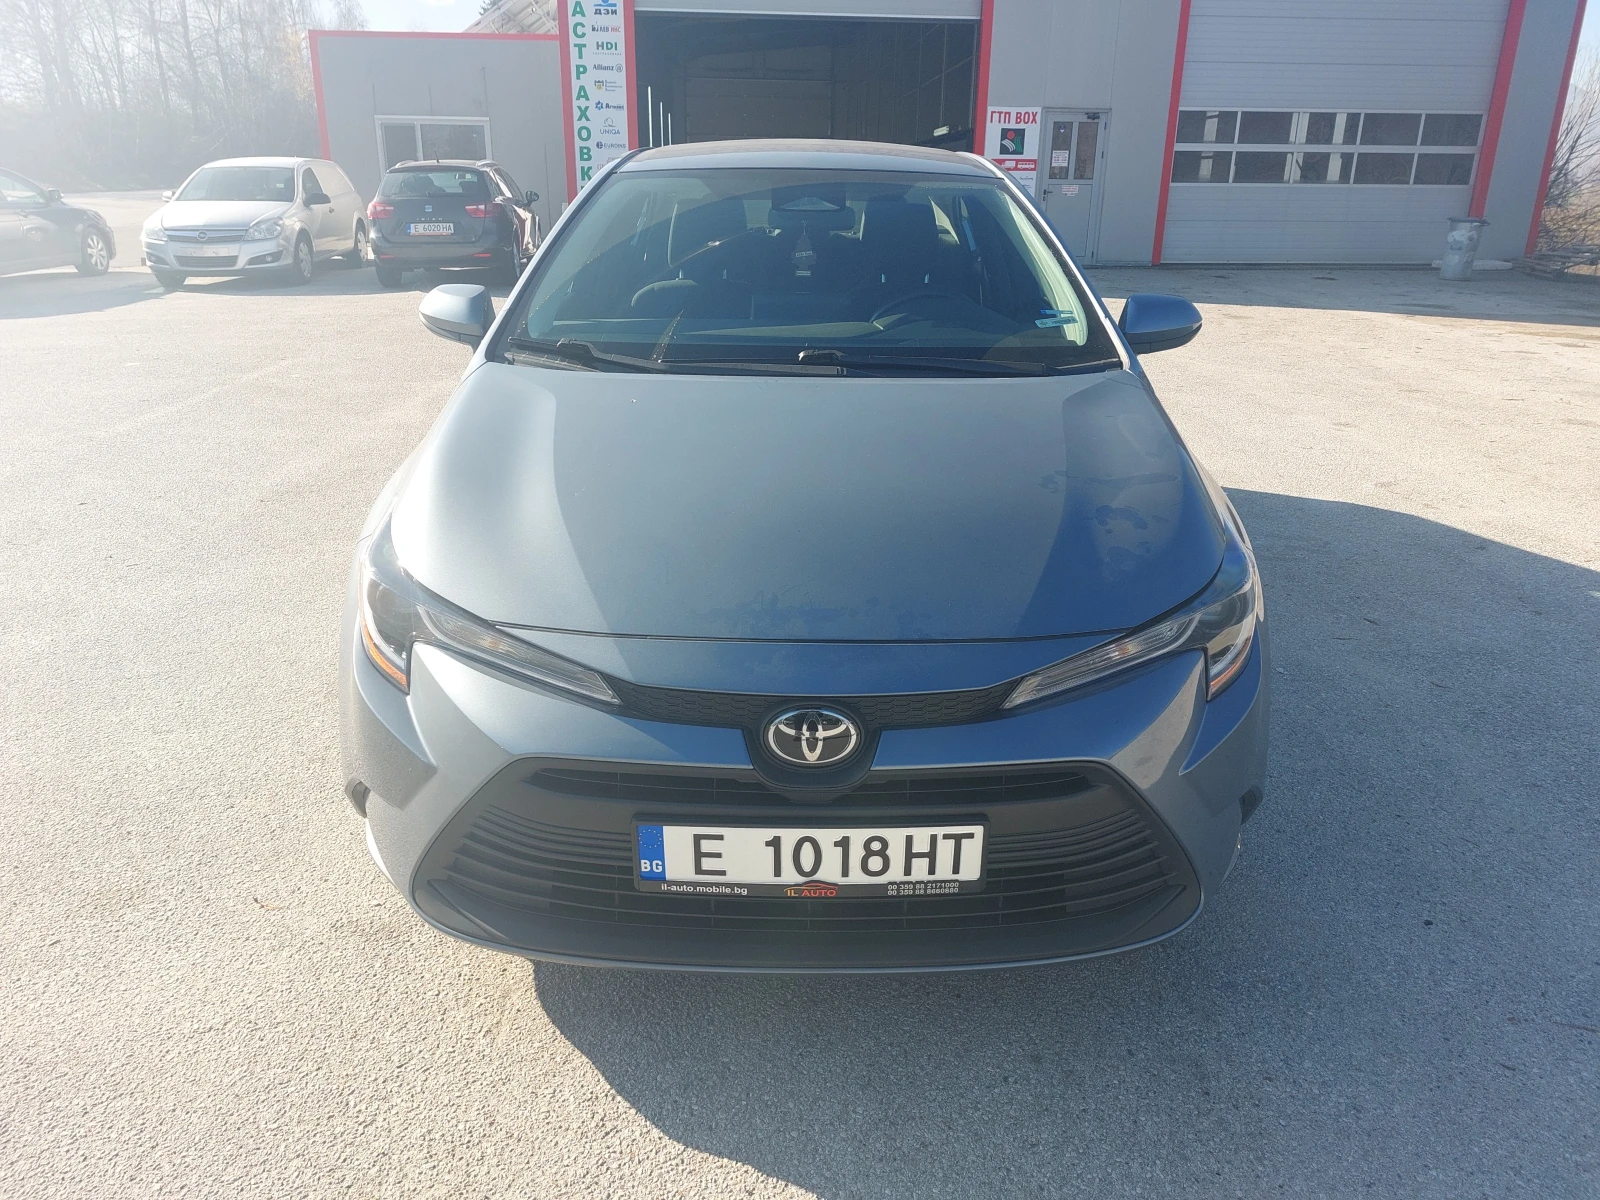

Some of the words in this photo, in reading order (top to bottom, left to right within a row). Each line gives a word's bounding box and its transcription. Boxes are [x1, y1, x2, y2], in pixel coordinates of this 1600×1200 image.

[593, 8, 618, 16] ДЗИ
[596, 41, 618, 51] HDI
[592, 63, 615, 71] Allianz
[571, 0, 592, 190] АСТРАХОВК
[990, 111, 1011, 124] ГТП
[692, 833, 727, 876] E
[640, 860, 663, 873] BG
[661, 884, 748, 895] il-auto.mobile.bg
[787, 888, 799, 897] IL
[801, 887, 837, 898] AUTO
